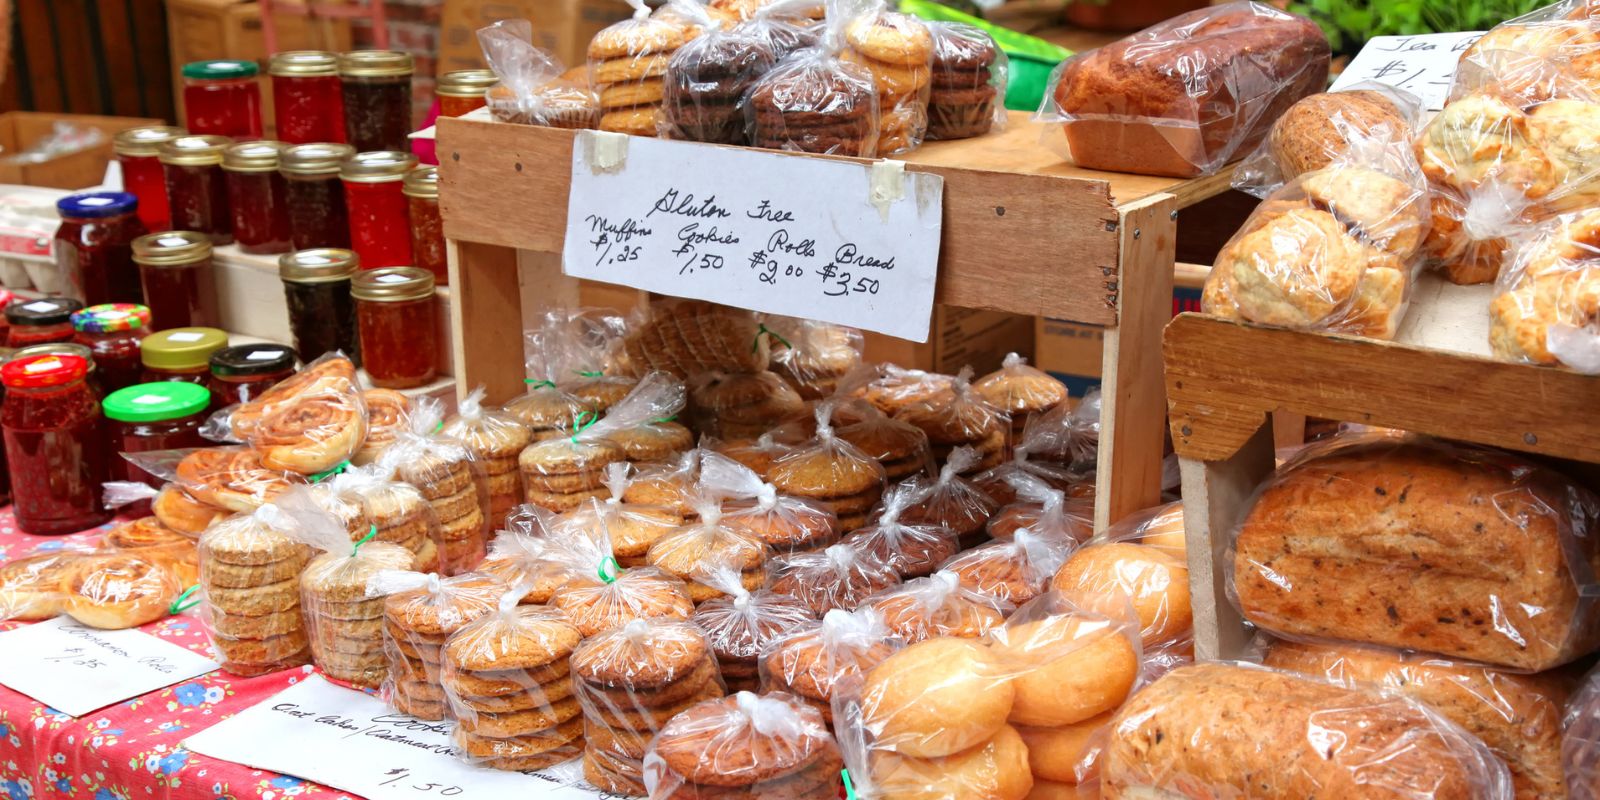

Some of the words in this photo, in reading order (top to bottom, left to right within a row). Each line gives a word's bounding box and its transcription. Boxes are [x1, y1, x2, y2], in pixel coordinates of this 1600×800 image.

[1376, 37, 1438, 53] Tea
[747, 200, 795, 223] Free
[584, 214, 653, 244] Muffins
[677, 222, 741, 246] Cookies
[767, 229, 816, 257] Rolls
[835, 243, 895, 271] Bread
[589, 232, 643, 266] $1.25
[671, 242, 724, 275] $1.50
[748, 250, 803, 285] $2.00
[815, 262, 880, 297] $3.50
